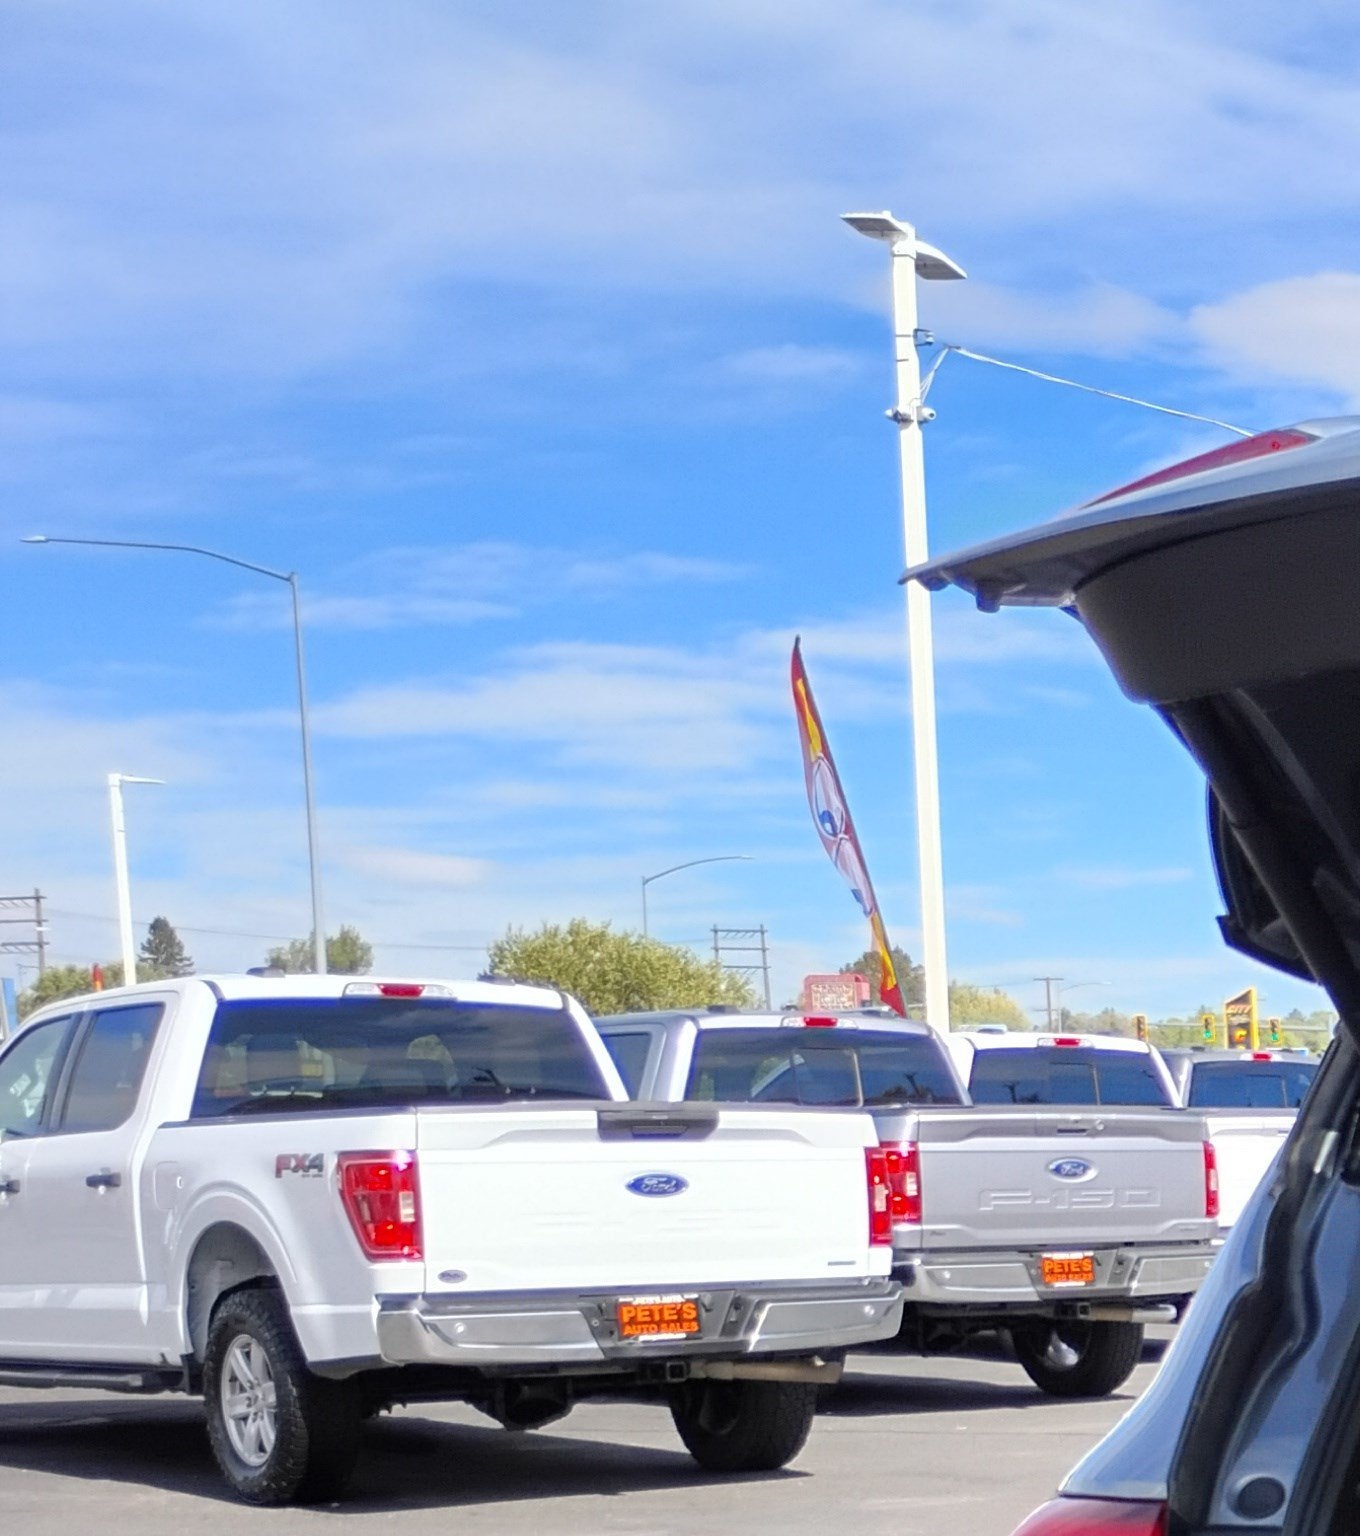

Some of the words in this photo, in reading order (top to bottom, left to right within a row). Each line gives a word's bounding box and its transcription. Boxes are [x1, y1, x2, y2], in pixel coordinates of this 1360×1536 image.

[275, 1153, 324, 1179] FX4
[1060, 1163, 1085, 1176] Ford
[641, 1177, 678, 1193] Ford
[978, 1187, 1161, 1211] F-150
[622, 1302, 697, 1322] PETE'S
[623, 1323, 659, 1336] AUTO
[660, 1321, 700, 1334] SALES
